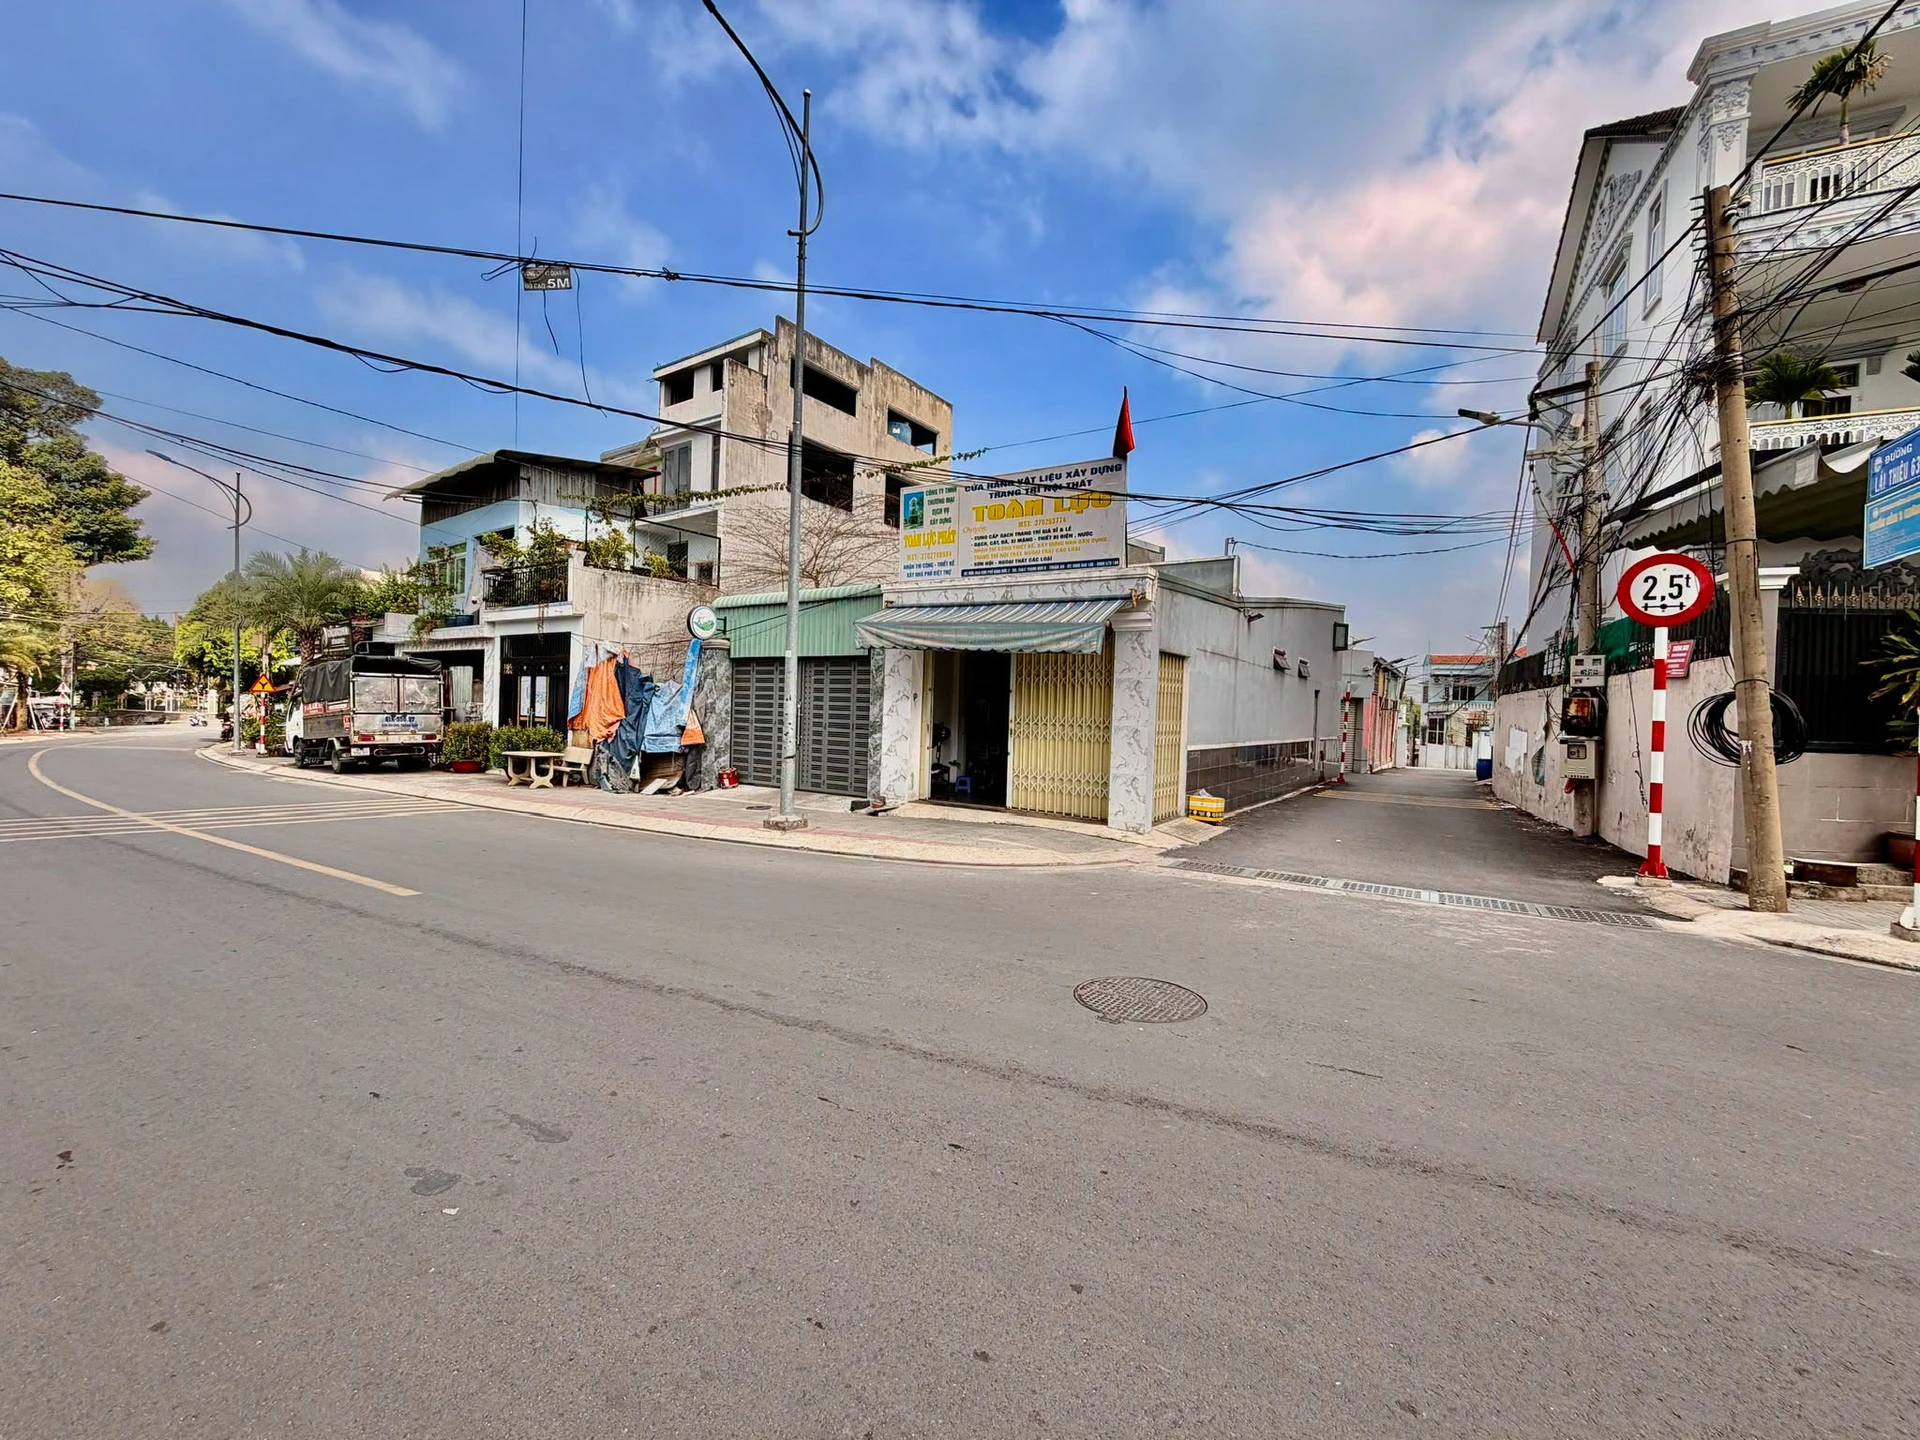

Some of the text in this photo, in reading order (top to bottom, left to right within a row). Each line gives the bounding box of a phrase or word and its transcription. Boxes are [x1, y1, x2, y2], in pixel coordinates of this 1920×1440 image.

[547, 278, 570, 289] 5M
[1885, 443, 1912, 465] ĐƯỜNG
[965, 483, 984, 492] CỬA
[1039, 472, 1062, 483] LIỆU
[1066, 468, 1087, 479] XÂY
[1090, 464, 1122, 476] DỰNG
[926, 488, 938, 496] CÔNG
[989, 488, 1022, 499] TRANG
[1066, 478, 1093, 490] THẤT
[944, 507, 950, 516] VỤ
[972, 491, 1112, 523] TOÀN LỰC
[939, 517, 952, 526] DỰNG
[938, 526, 956, 545] PHÁT
